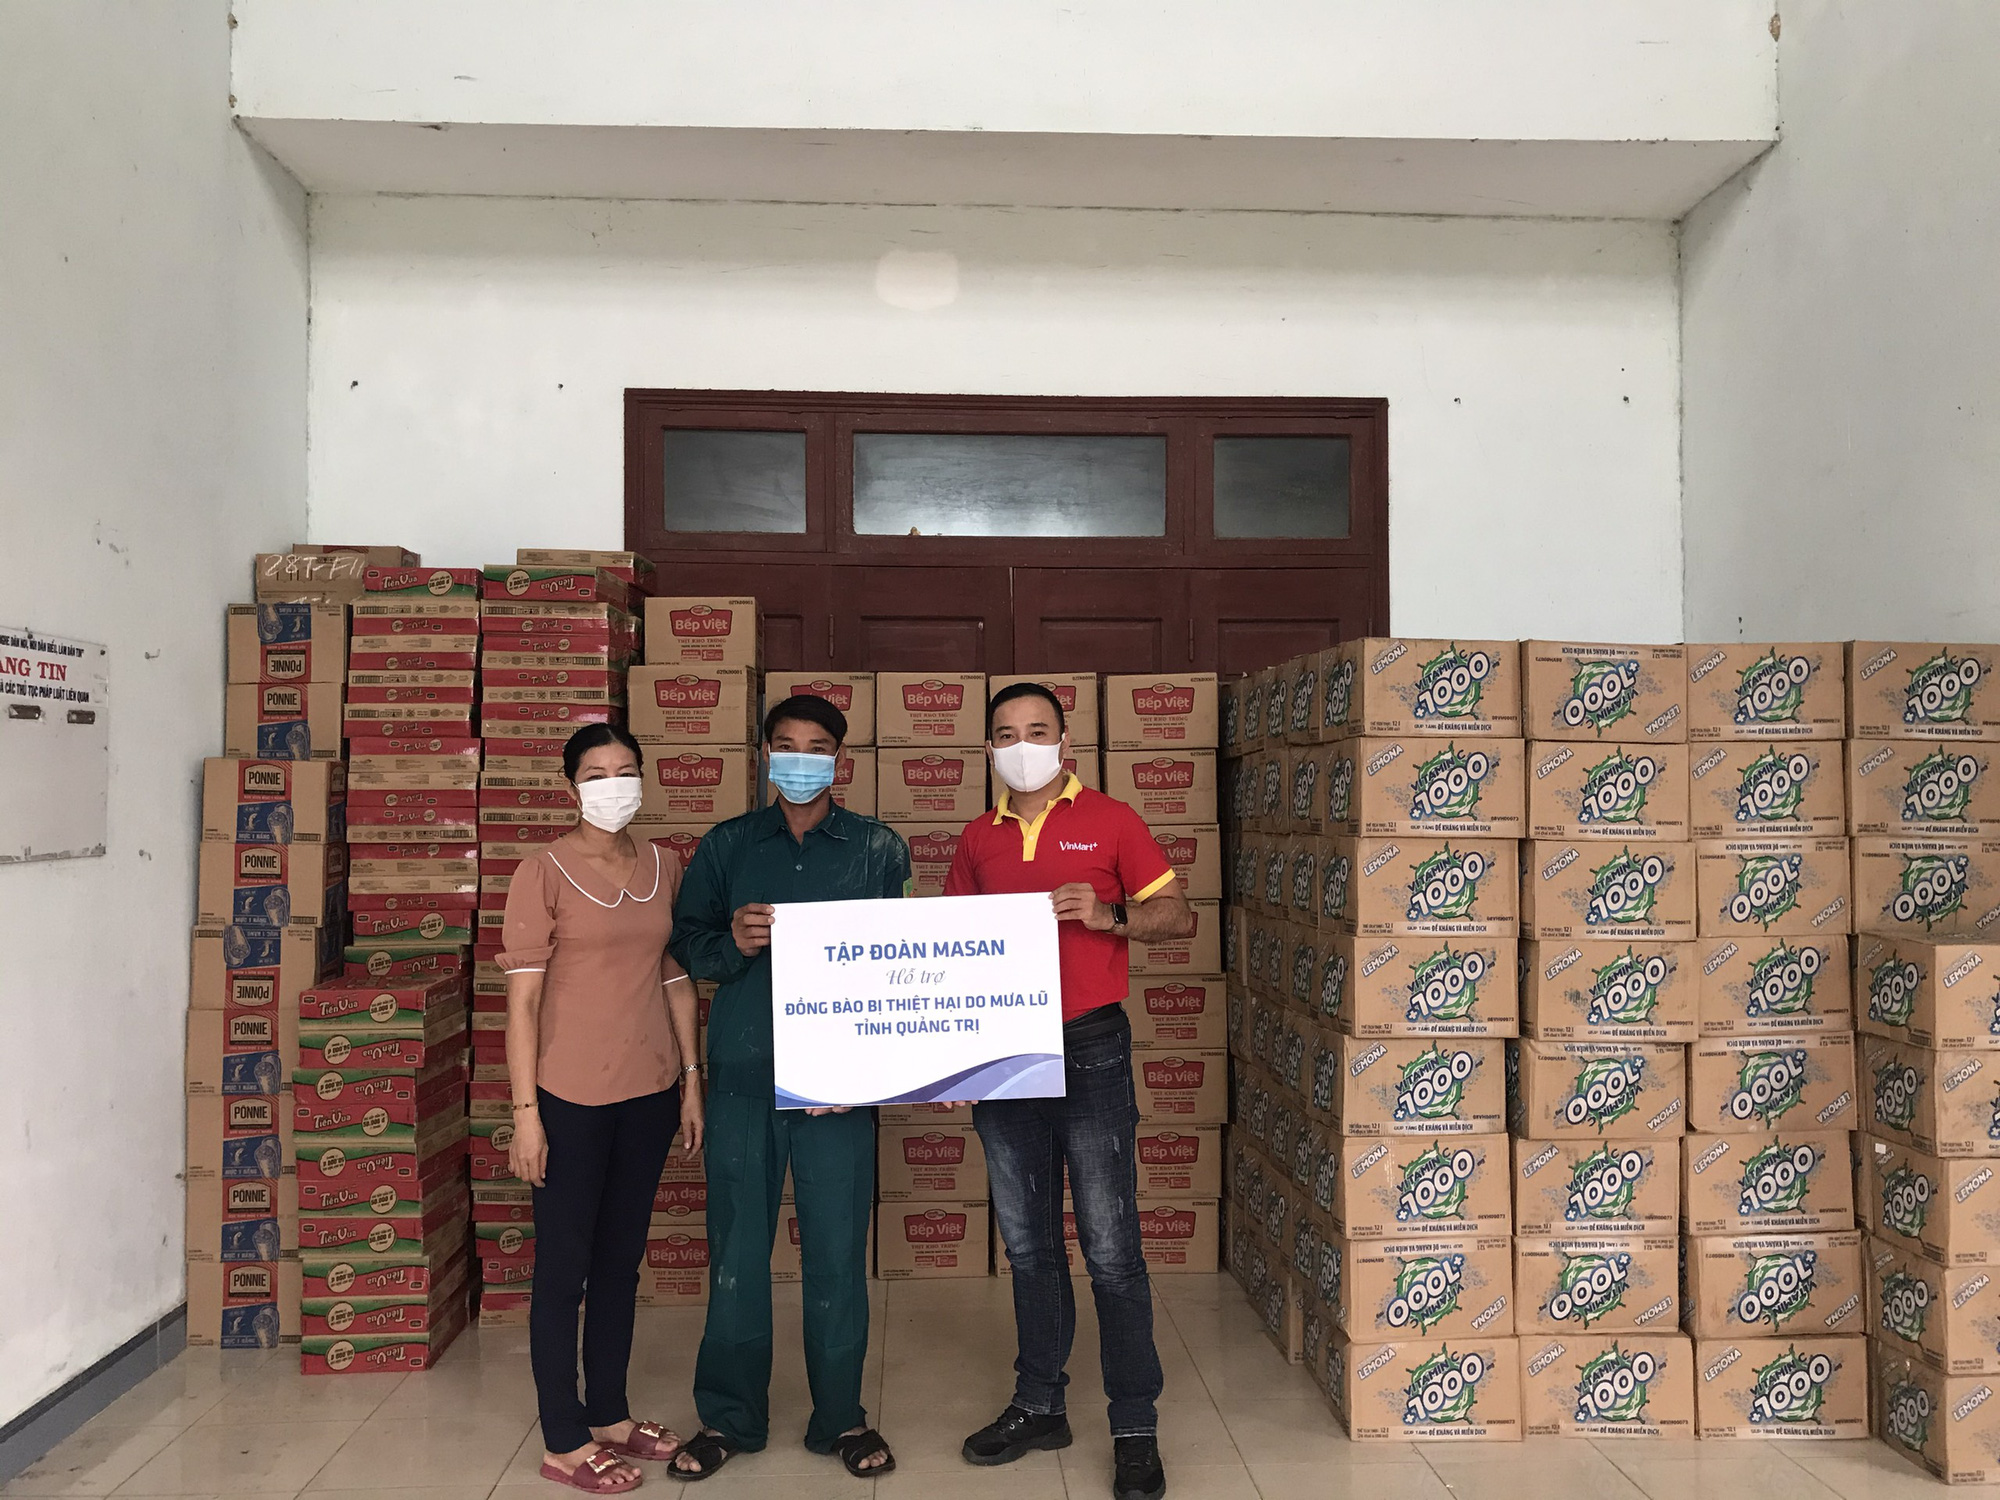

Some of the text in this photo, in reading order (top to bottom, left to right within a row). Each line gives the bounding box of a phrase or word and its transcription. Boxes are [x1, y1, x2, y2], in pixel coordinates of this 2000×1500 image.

[37, 662, 67, 681] TIN
[1371, 644, 1408, 674] LEMONA
[1415, 657, 1458, 690] VITAMIN
[1690, 650, 1726, 682] LEMONA
[1860, 649, 1898, 680] LEMONA
[1644, 704, 1682, 736] LEMONA
[1366, 744, 1404, 776] LEMONA
[1410, 757, 1456, 791] VITAMIN
[1536, 748, 1574, 780] LEMONA
[1692, 749, 1727, 780] LEMONA
[1858, 746, 1895, 777] LEMONA
[1363, 844, 1400, 878] LEMONA
[1542, 848, 1580, 880] LEMONA
[1810, 896, 1845, 928] LEMONA
[824, 939, 1005, 966] TẬP ĐOÀN MASAN
[1361, 944, 1400, 978] LEMONA
[1545, 948, 1582, 981] LEMONA
[1703, 942, 1738, 976] LEMONA
[886, 968, 946, 984] Hỗ trợ
[1943, 953, 1983, 988] LEMONA
[785, 990, 1048, 1016] ĐỒNG BÀO BỊ THIỆT HẠI DO MƯA LŨ
[855, 1018, 980, 1036] TỈNH QUẢNG TRỊ
[1350, 1044, 1388, 1078] LEMONA
[1943, 1059, 1983, 1093] LEMONA
[1646, 1098, 1682, 1130] LEMONA
[1816, 1090, 1851, 1123] LEMONA
[1351, 1144, 1388, 1179] LEMONA
[1522, 1144, 1560, 1179] LEMONA
[1693, 1141, 1730, 1174] LEMONA
[1955, 1168, 1993, 1203] LEMONA
[1953, 1274, 1990, 1310] LEMONA
[1471, 1296, 1508, 1330] LEMONA
[1634, 1296, 1673, 1326] LEMONA
[1824, 1294, 1860, 1327] LEMONA
[1357, 1348, 1396, 1380] LEMONA
[1527, 1344, 1566, 1378] LEMONA
[1704, 1348, 1742, 1382] LEMONA
[1953, 1385, 1994, 1422] LEMONA
